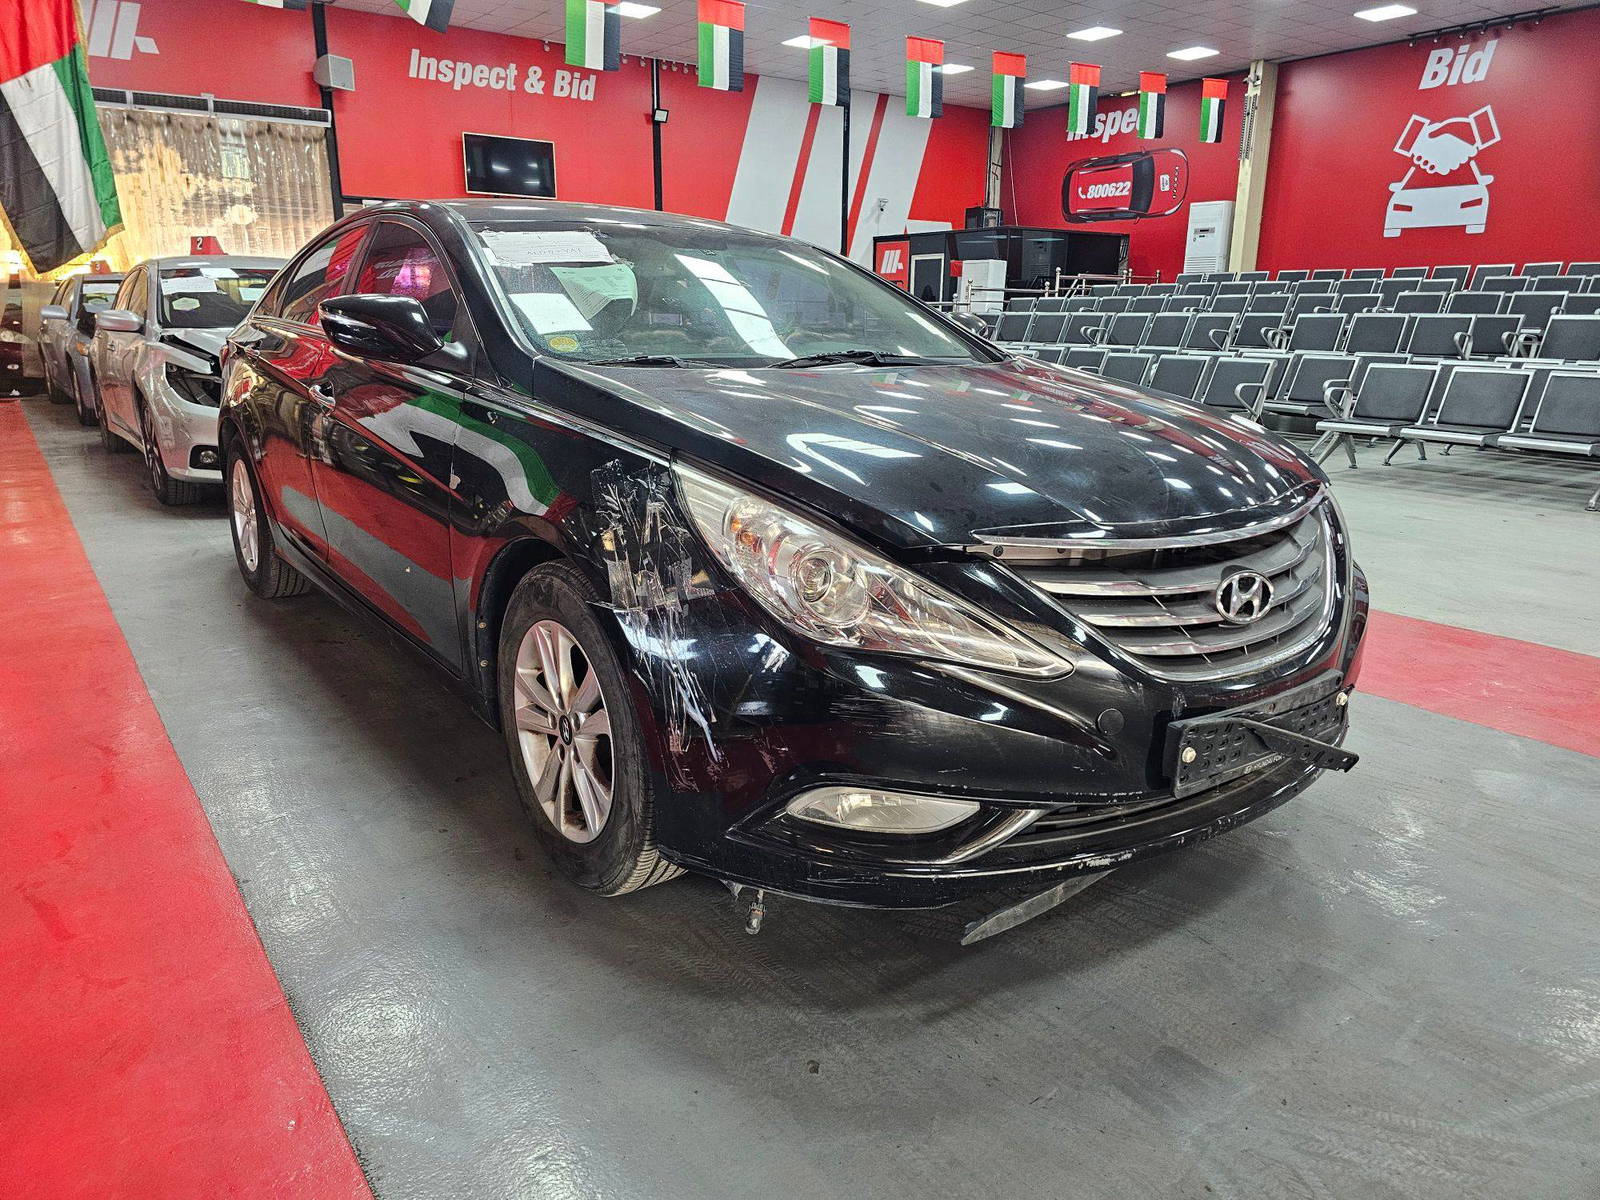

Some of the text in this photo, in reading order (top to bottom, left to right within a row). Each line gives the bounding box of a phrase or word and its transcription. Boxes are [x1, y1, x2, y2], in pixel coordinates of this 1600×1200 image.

[408, 48, 597, 102] Inspect & Bid
[1418, 39, 1498, 90] Bid
[1086, 181, 1132, 199] 800622
[196, 236, 203, 251] 2
